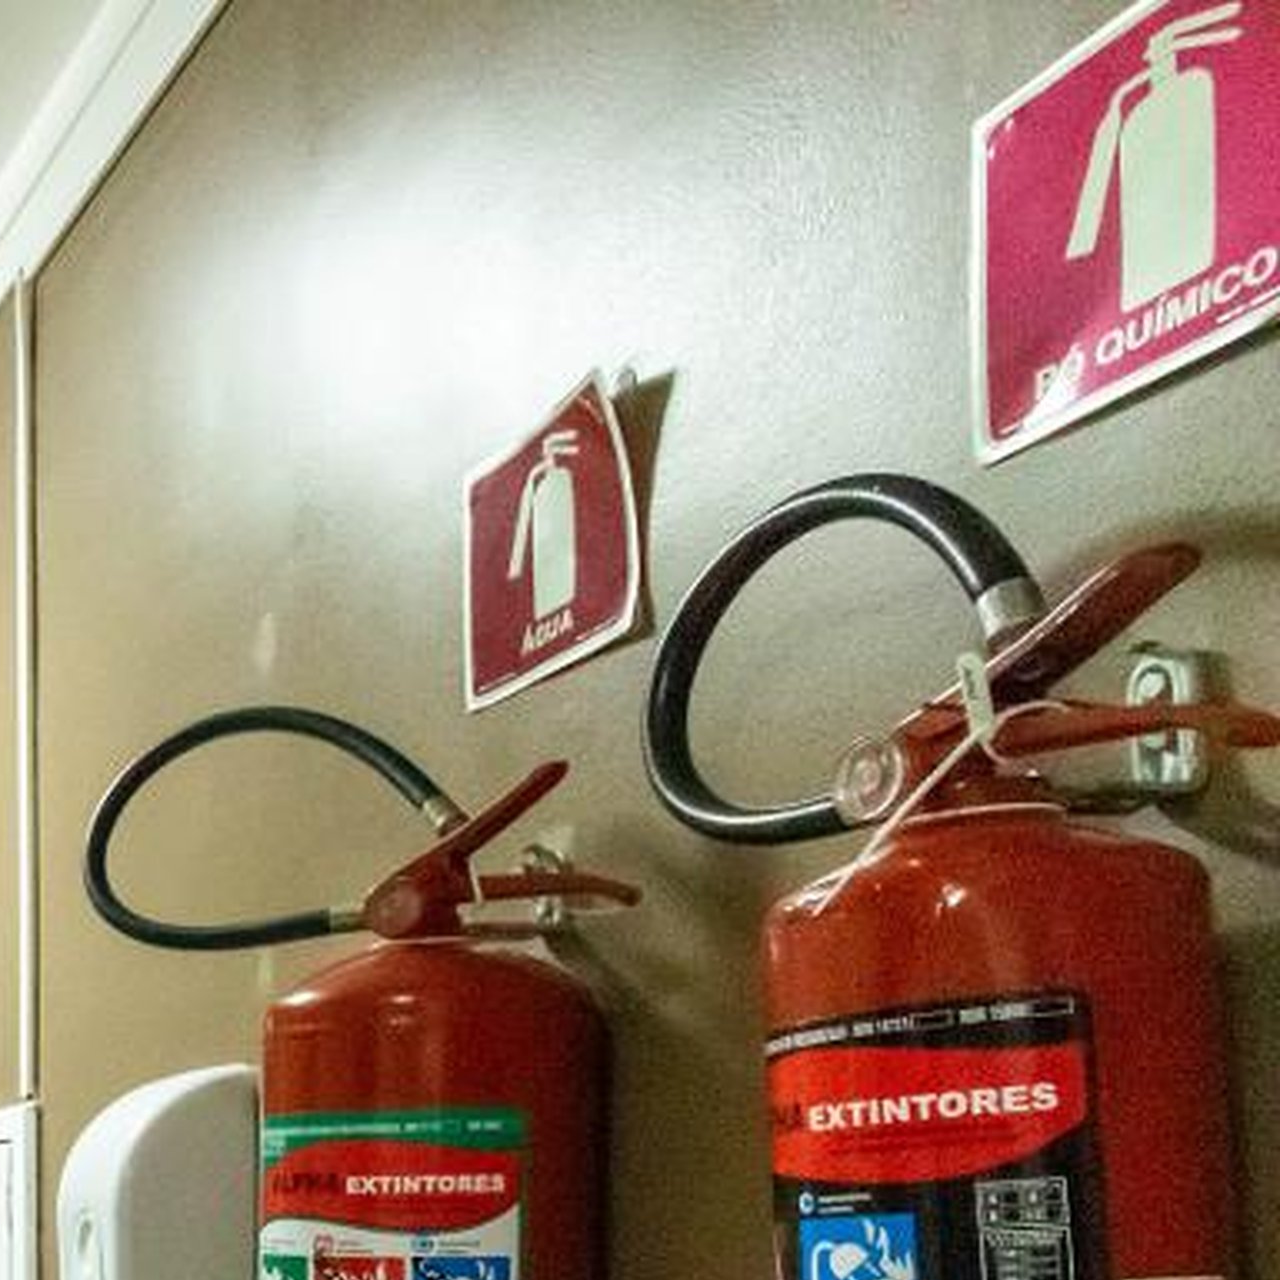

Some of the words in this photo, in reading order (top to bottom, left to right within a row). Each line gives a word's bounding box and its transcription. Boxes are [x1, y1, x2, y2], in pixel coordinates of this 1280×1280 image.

[1095, 246, 1279, 365] QUÍMICO
[807, 1081, 1059, 1133] EXTINTORES
[345, 1173, 506, 1196] EXTINTORES
